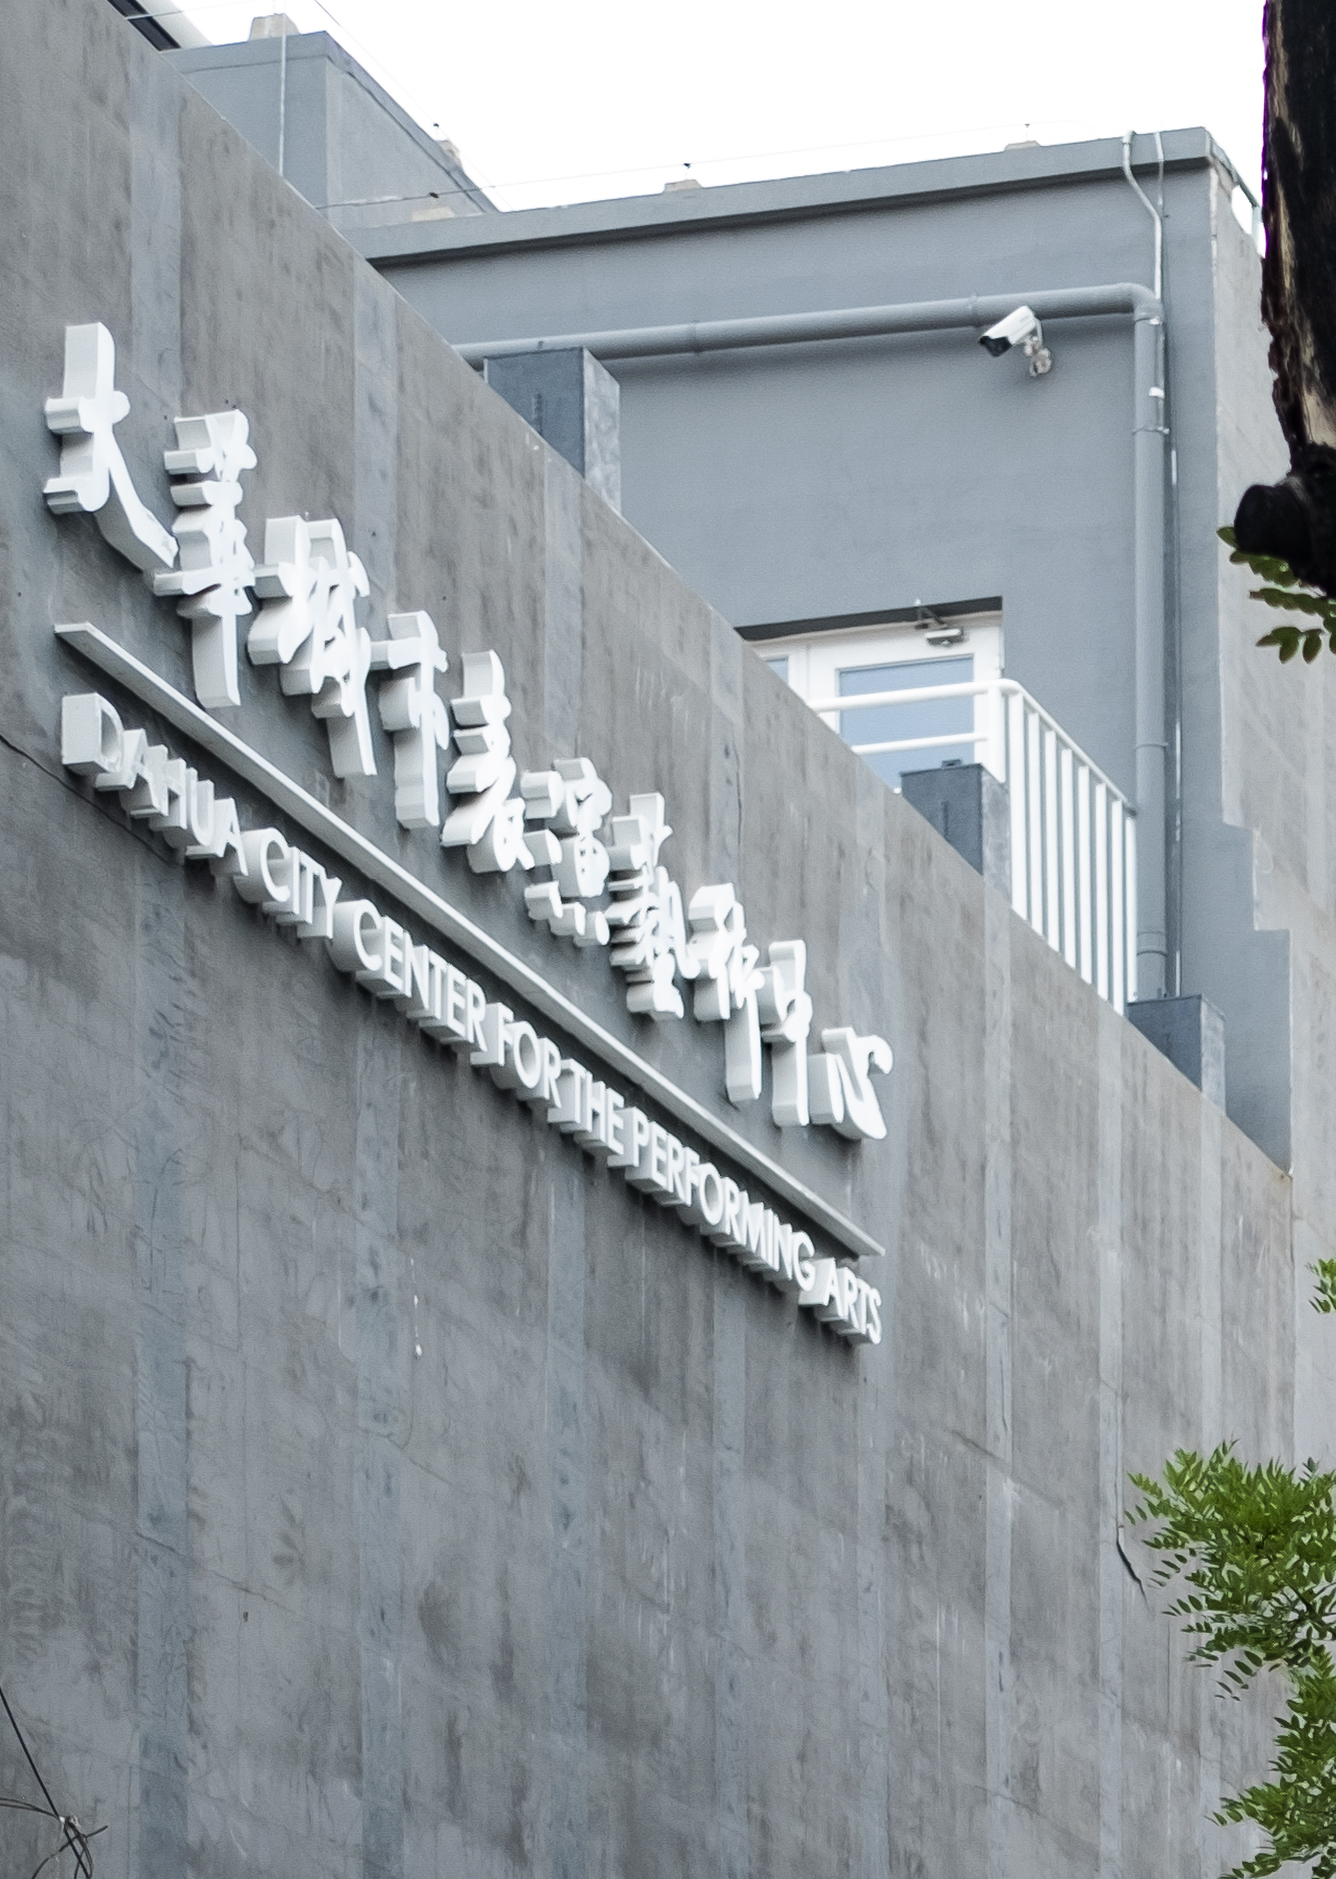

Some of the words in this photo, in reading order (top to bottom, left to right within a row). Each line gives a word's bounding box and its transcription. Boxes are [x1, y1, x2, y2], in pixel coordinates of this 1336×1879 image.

[61, 692, 248, 877] DAHUA
[233, 827, 343, 939] CITY
[325, 899, 488, 1053] CENTER
[470, 1002, 562, 1109] FOR
[547, 1058, 625, 1156] THE
[607, 1106, 815, 1293] PERFORMING
[798, 1257, 883, 1345] ARTS
